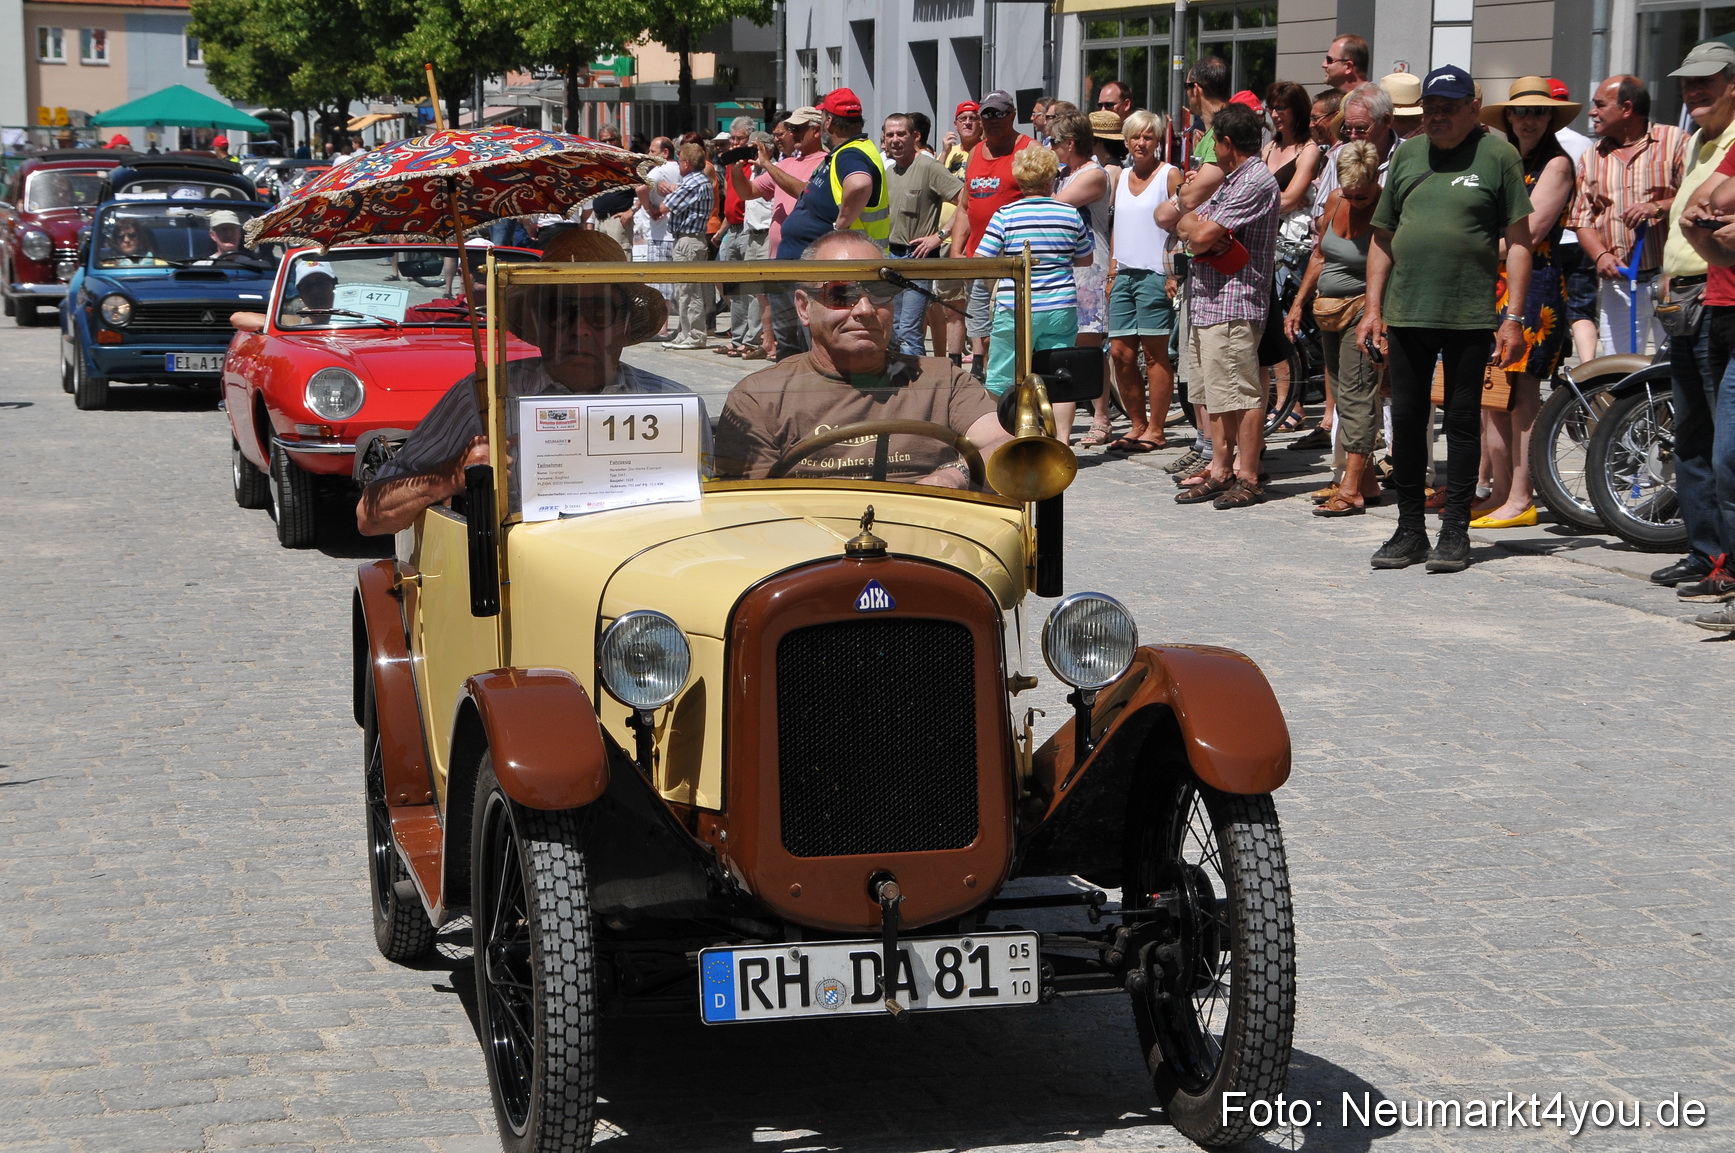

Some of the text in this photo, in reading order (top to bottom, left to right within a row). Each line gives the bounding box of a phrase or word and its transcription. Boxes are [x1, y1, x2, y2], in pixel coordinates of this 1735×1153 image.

[366, 292, 391, 302] 477
[176, 356, 190, 369] EI
[200, 356, 208, 369] A
[602, 414, 660, 441] 113
[799, 451, 911, 471] ber 60 Jahre gufen
[859, 587, 889, 609] DIXI
[1008, 943, 1030, 959] 05
[738, 953, 810, 1011] RH
[849, 950, 919, 1006] DA
[934, 944, 999, 999] 81
[1010, 979, 1032, 996] 10
[714, 993, 727, 1009] D
